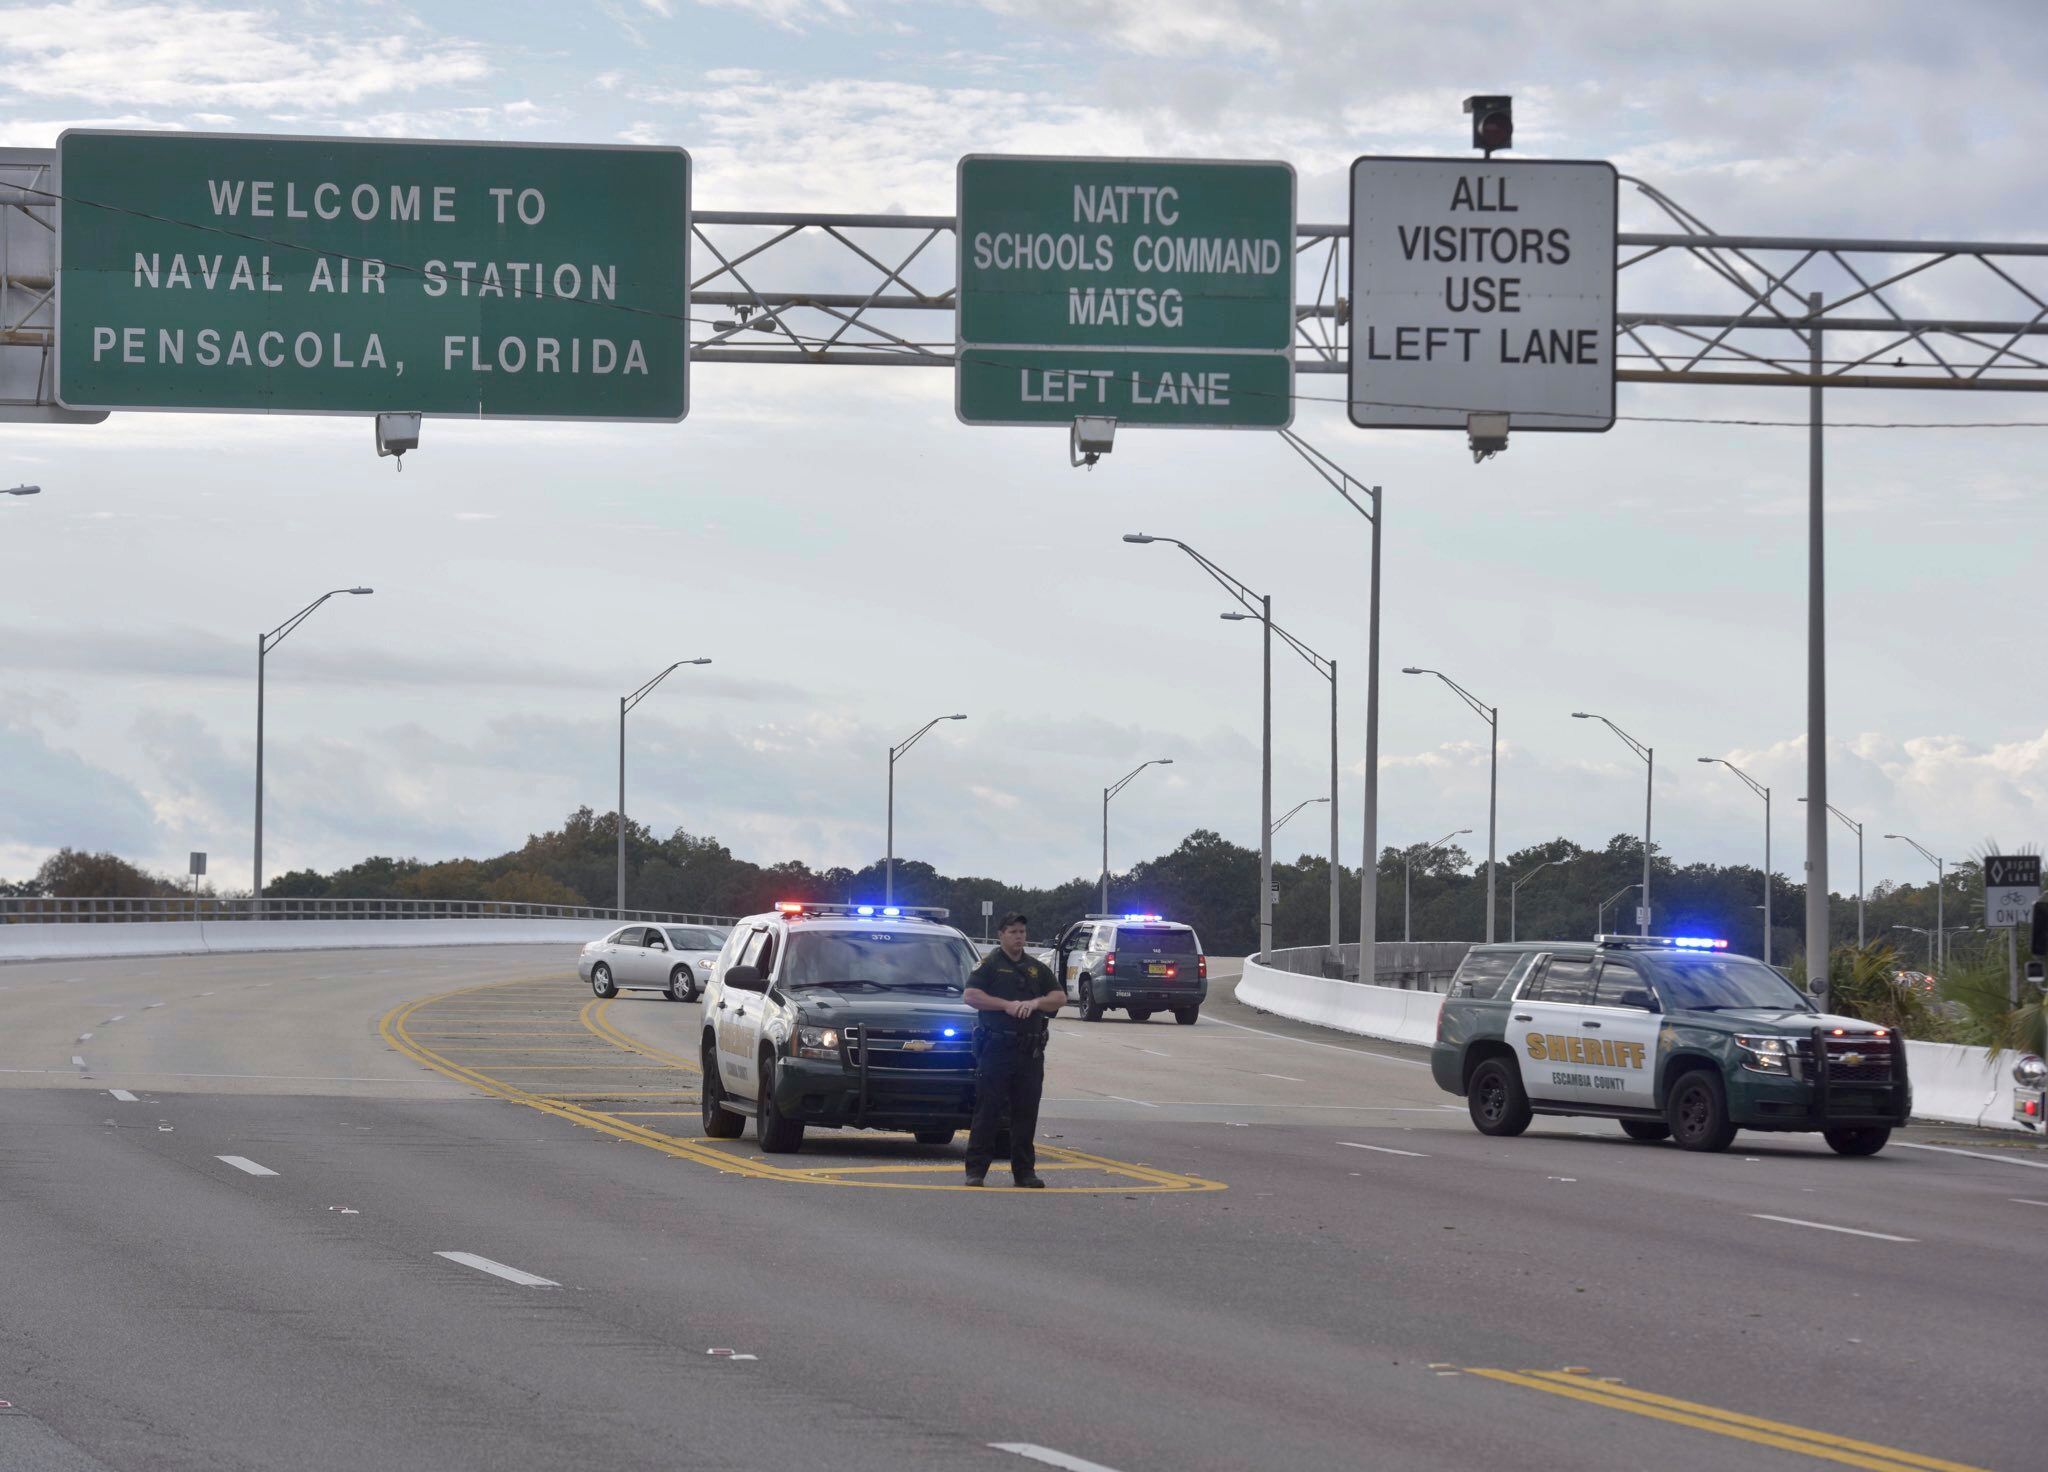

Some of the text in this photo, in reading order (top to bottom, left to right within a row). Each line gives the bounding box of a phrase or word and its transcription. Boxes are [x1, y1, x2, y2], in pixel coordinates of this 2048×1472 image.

[208, 180, 545, 225] WELCOME TO
[1074, 185, 1178, 225] NATTC
[1450, 176, 1518, 212] ALL
[974, 233, 1280, 273] SCHOOLS COMMAND
[1398, 226, 1570, 265] VISITORS
[135, 253, 615, 300] NAVAL AIR STATION
[1446, 276, 1520, 313] USE
[1070, 288, 1182, 327] MATSG
[94, 327, 648, 376] PENSACOLA, FLORIDA
[1369, 327, 1598, 364] LEFT LANE
[1022, 370, 1229, 405] LEFT LANE
[1525, 1032, 1647, 1069] SHERIFF
[1552, 1072, 1625, 1091] ESCAMBIA COUNTY
